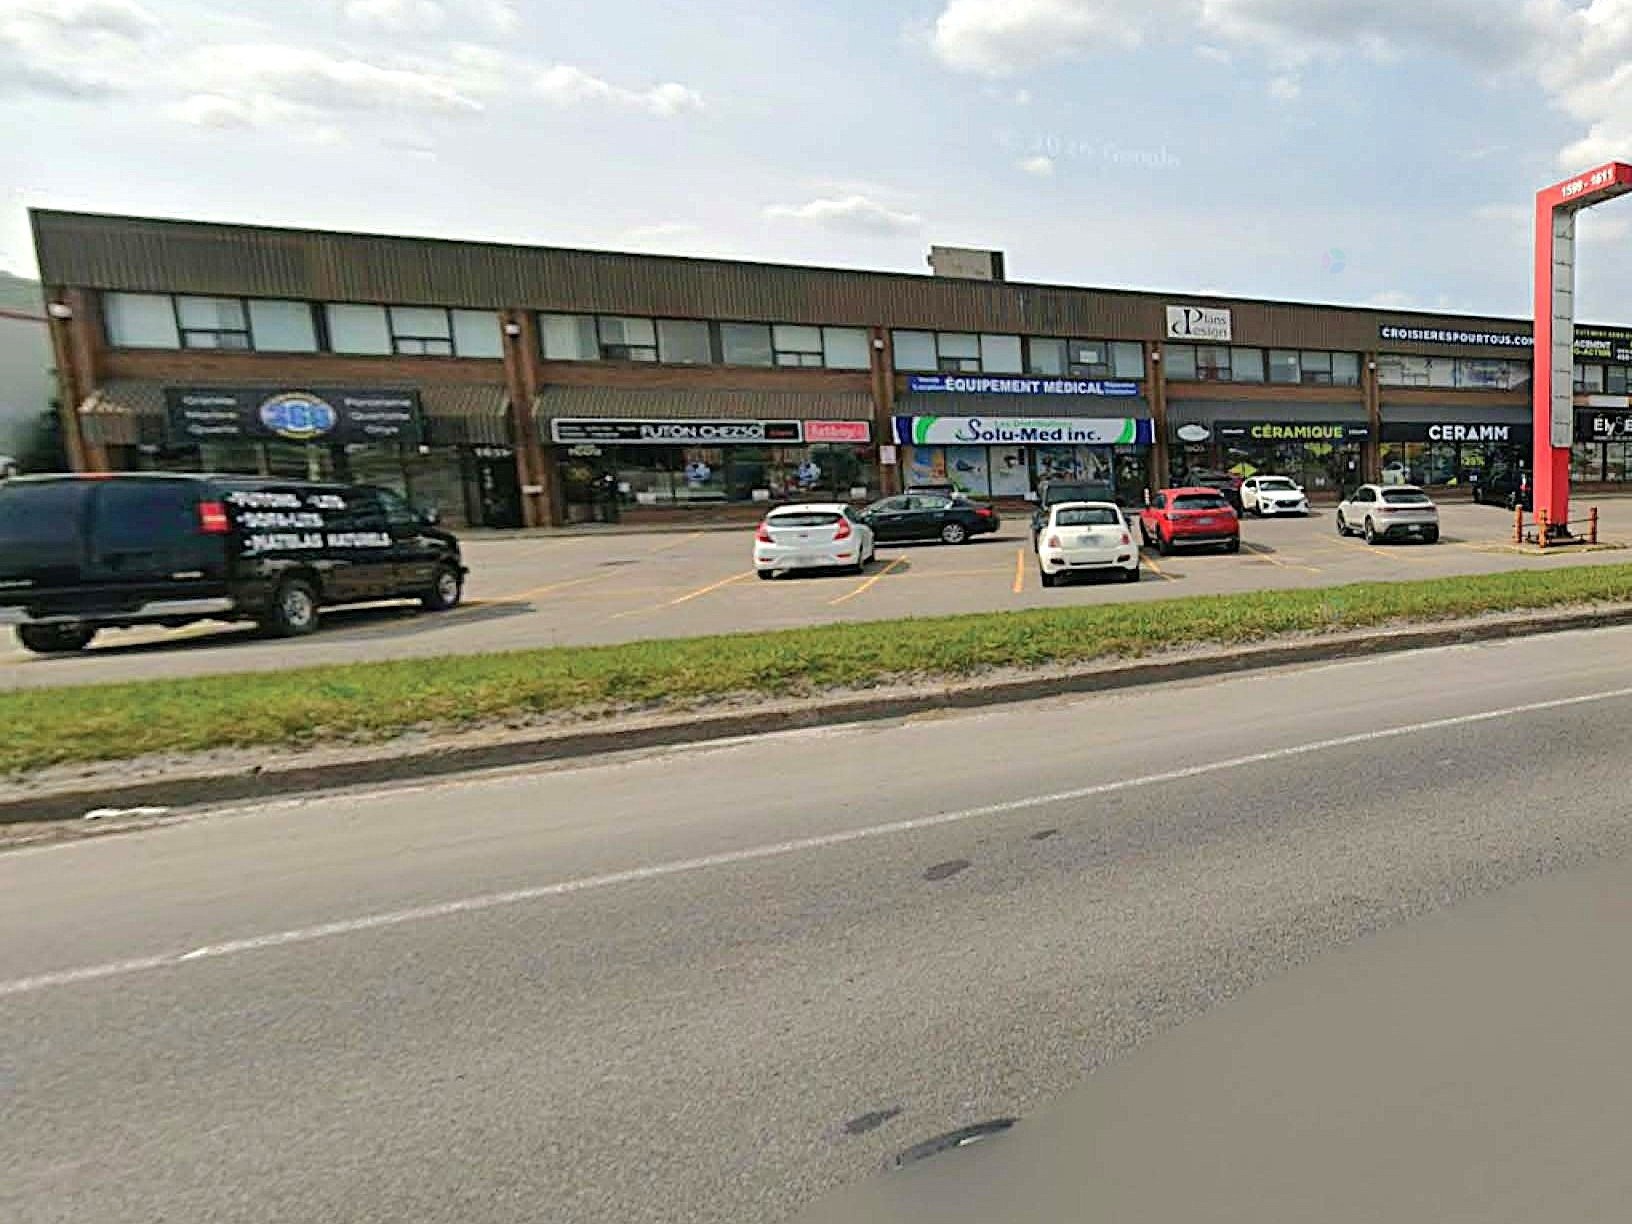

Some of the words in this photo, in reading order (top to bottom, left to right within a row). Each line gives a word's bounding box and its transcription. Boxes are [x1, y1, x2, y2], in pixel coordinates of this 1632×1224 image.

[945, 376, 1040, 393] ÉQUIPEMENT
[1043, 378, 1105, 396] MÉDICAL
[955, 418, 1063, 442] Solu-Med
[1068, 427, 1101, 442] inc.
[1251, 423, 1343, 439] CÉRAMIQUE
[1428, 424, 1509, 441] CERAMM
